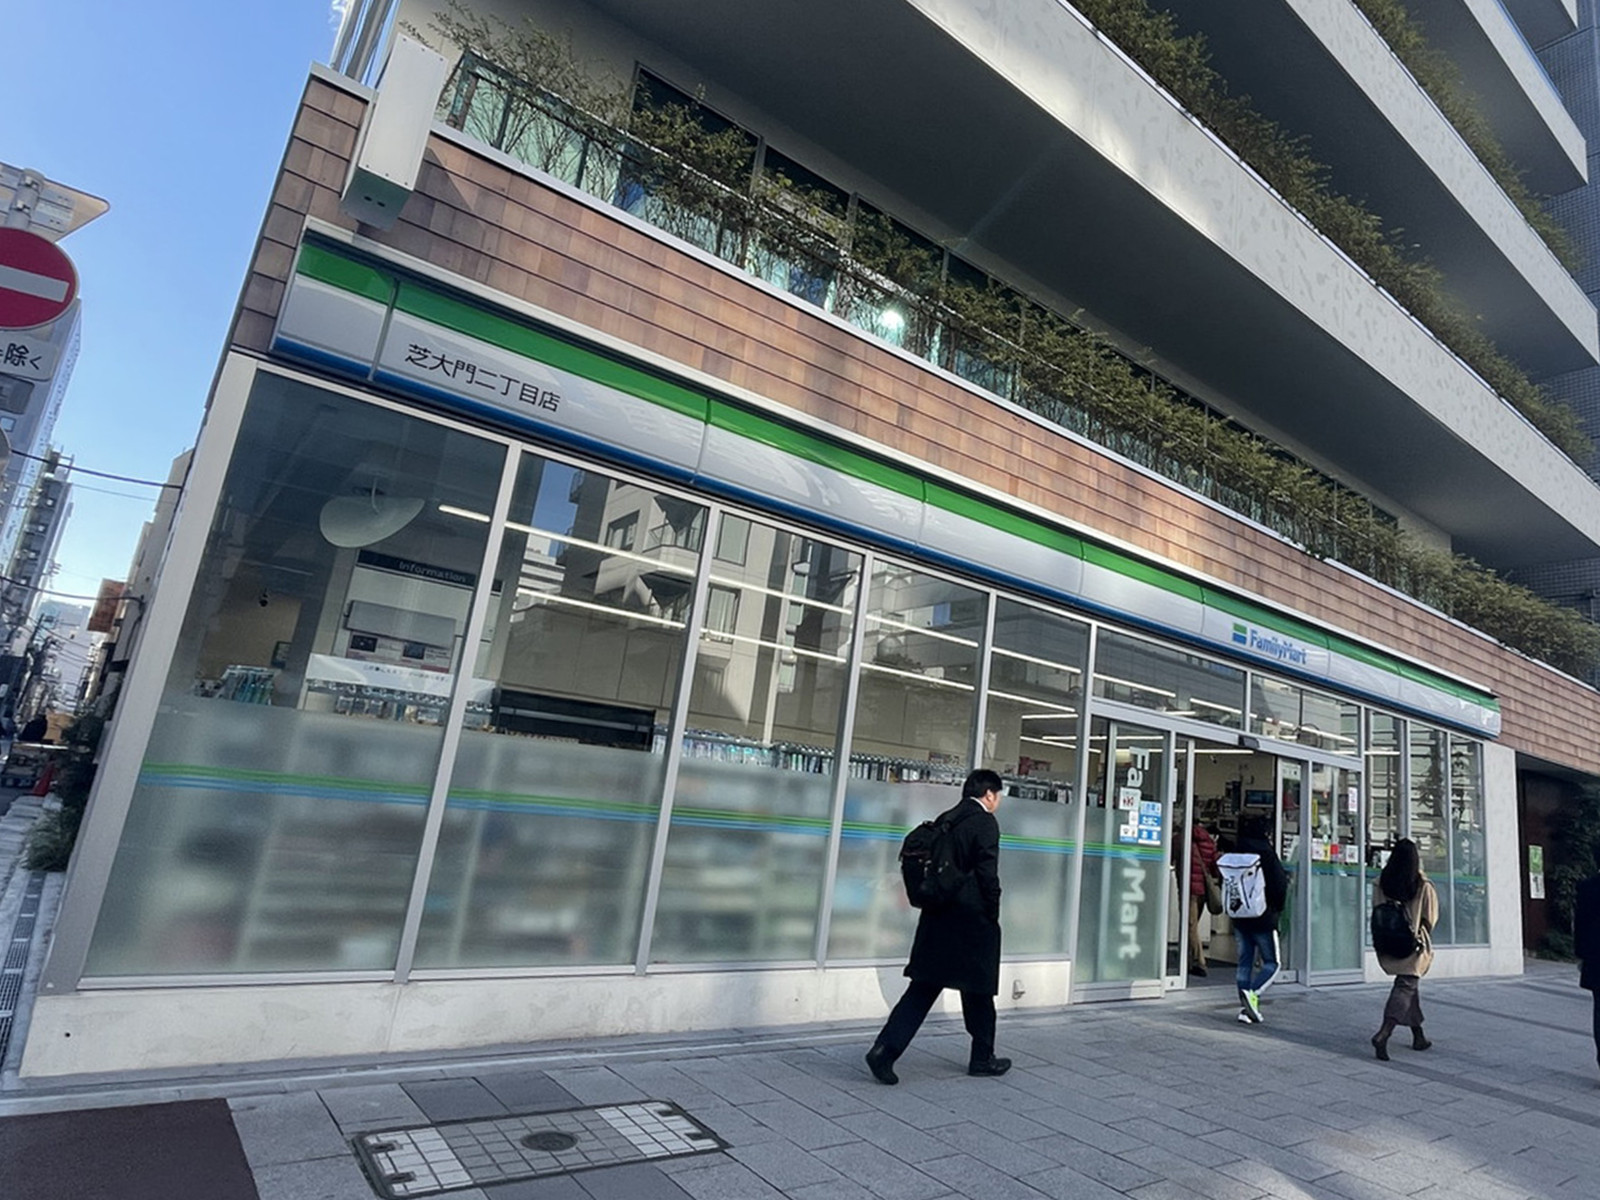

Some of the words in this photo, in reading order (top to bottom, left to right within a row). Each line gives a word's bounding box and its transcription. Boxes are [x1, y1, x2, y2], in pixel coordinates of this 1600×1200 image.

[0, 343, 42, 371] 除く
[405, 344, 561, 412] 芝大門二丁目店
[399, 561, 467, 582] Information
[1249, 628, 1307, 665] FamilyMart
[1119, 746, 1150, 959] FaMart
